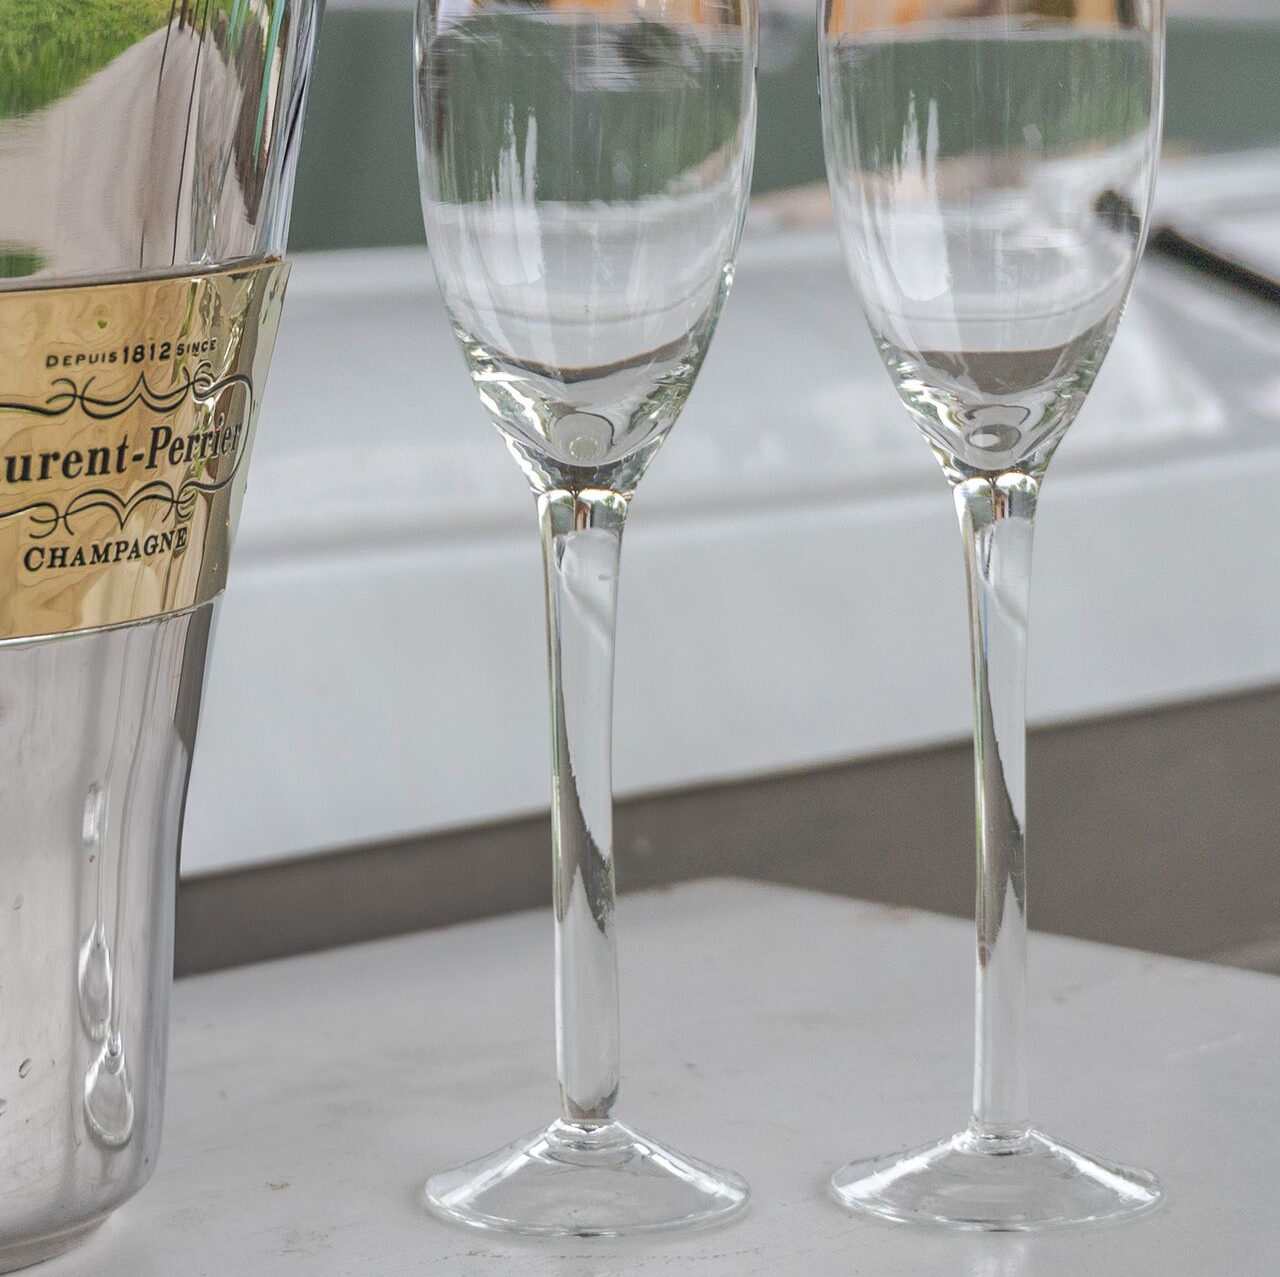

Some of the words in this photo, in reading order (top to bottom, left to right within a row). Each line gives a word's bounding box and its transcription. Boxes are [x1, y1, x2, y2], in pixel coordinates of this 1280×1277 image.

[46, 351, 118, 368] DEPUIS
[123, 342, 171, 364] 1812
[176, 338, 218, 357] SINCE
[23, 527, 188, 572] CHAMPAGNE
